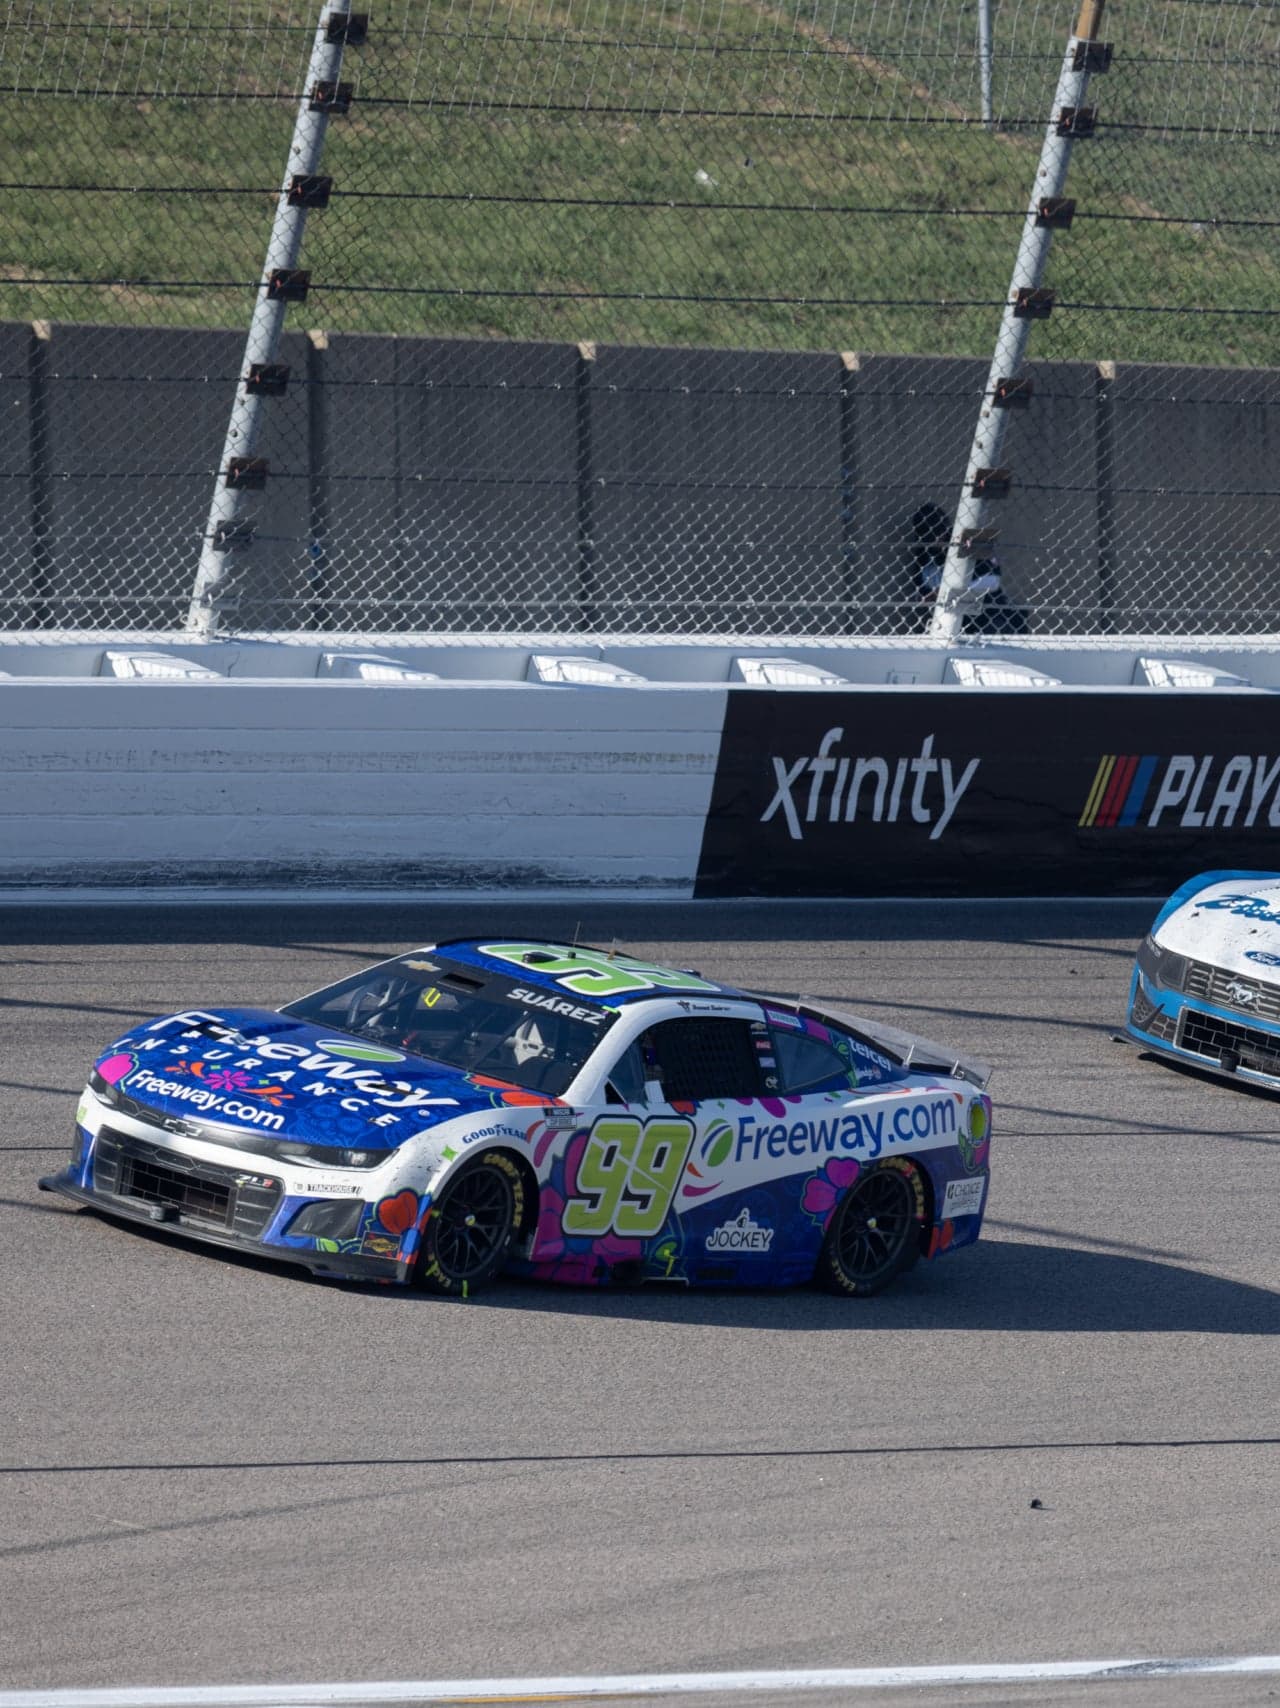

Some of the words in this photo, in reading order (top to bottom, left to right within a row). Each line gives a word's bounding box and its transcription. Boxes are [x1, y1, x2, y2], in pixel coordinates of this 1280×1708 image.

[760, 727, 981, 839] xfinity
[507, 987, 606, 1026] SUÁREZ
[111, 1038, 402, 1128] INSURANCE
[148, 1010, 461, 1108] Freeway
[848, 1036, 893, 1073] telcel
[126, 1069, 286, 1131] Freeway.com
[462, 1113, 529, 1144] GOODYEAR
[735, 1097, 957, 1159] Freeway.com
[562, 1115, 696, 1238] 99
[706, 1231, 771, 1249] JOCKEY
